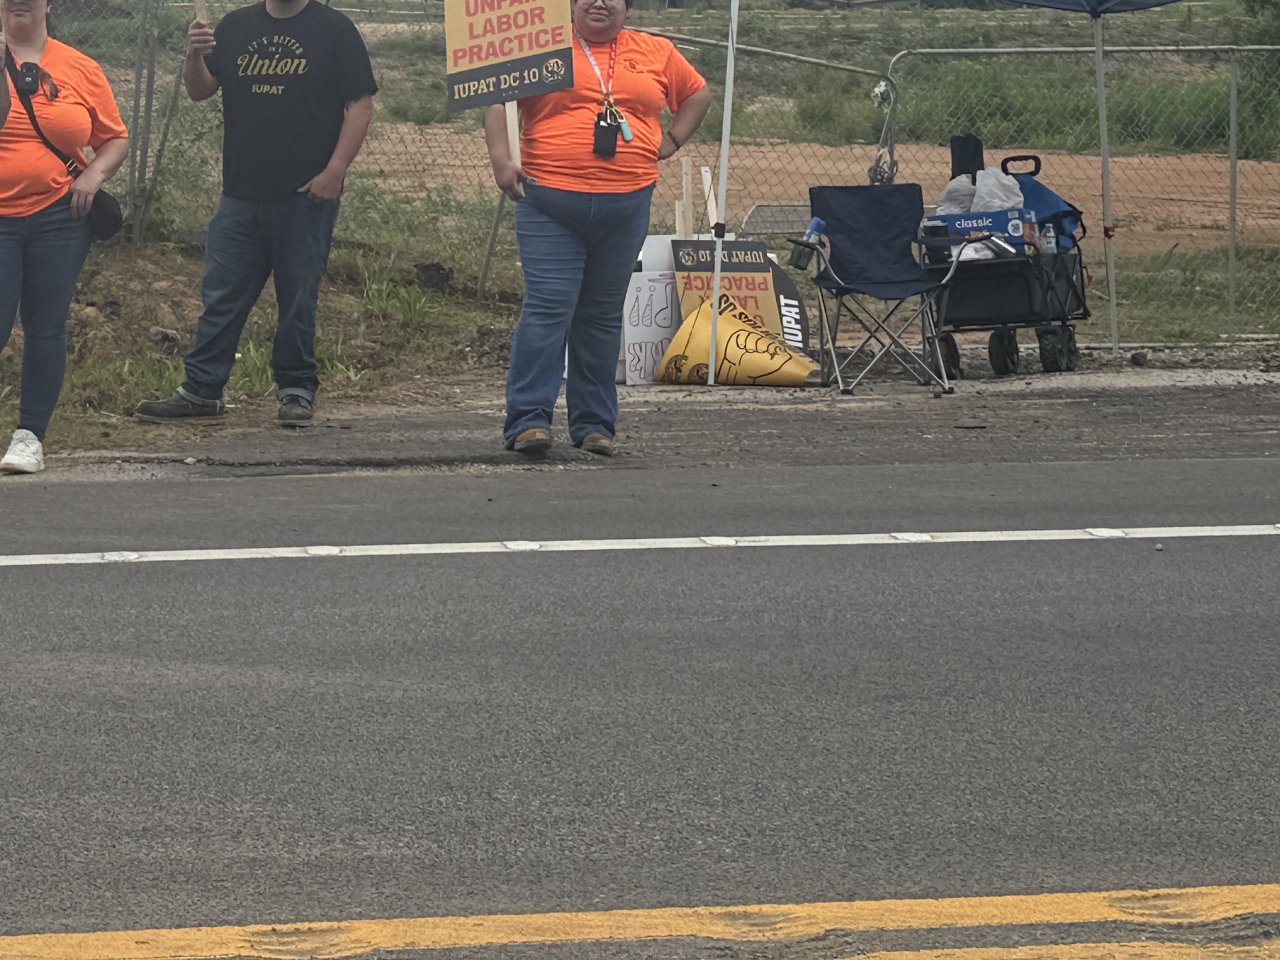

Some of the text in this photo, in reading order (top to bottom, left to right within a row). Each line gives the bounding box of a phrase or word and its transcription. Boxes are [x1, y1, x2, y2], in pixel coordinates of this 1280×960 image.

[468, 6, 545, 40] LABOR
[452, 25, 566, 68] PRACTICE
[237, 54, 310, 76] Union
[252, 84, 284, 94] IUPAT
[453, 68, 539, 100] IUPAT DC 10
[955, 218, 993, 229] classic
[699, 250, 711, 262] 10
[731, 250, 764, 263] IUPAT
[681, 275, 769, 291] PRACICE
[779, 294, 803, 348] IUPAT
